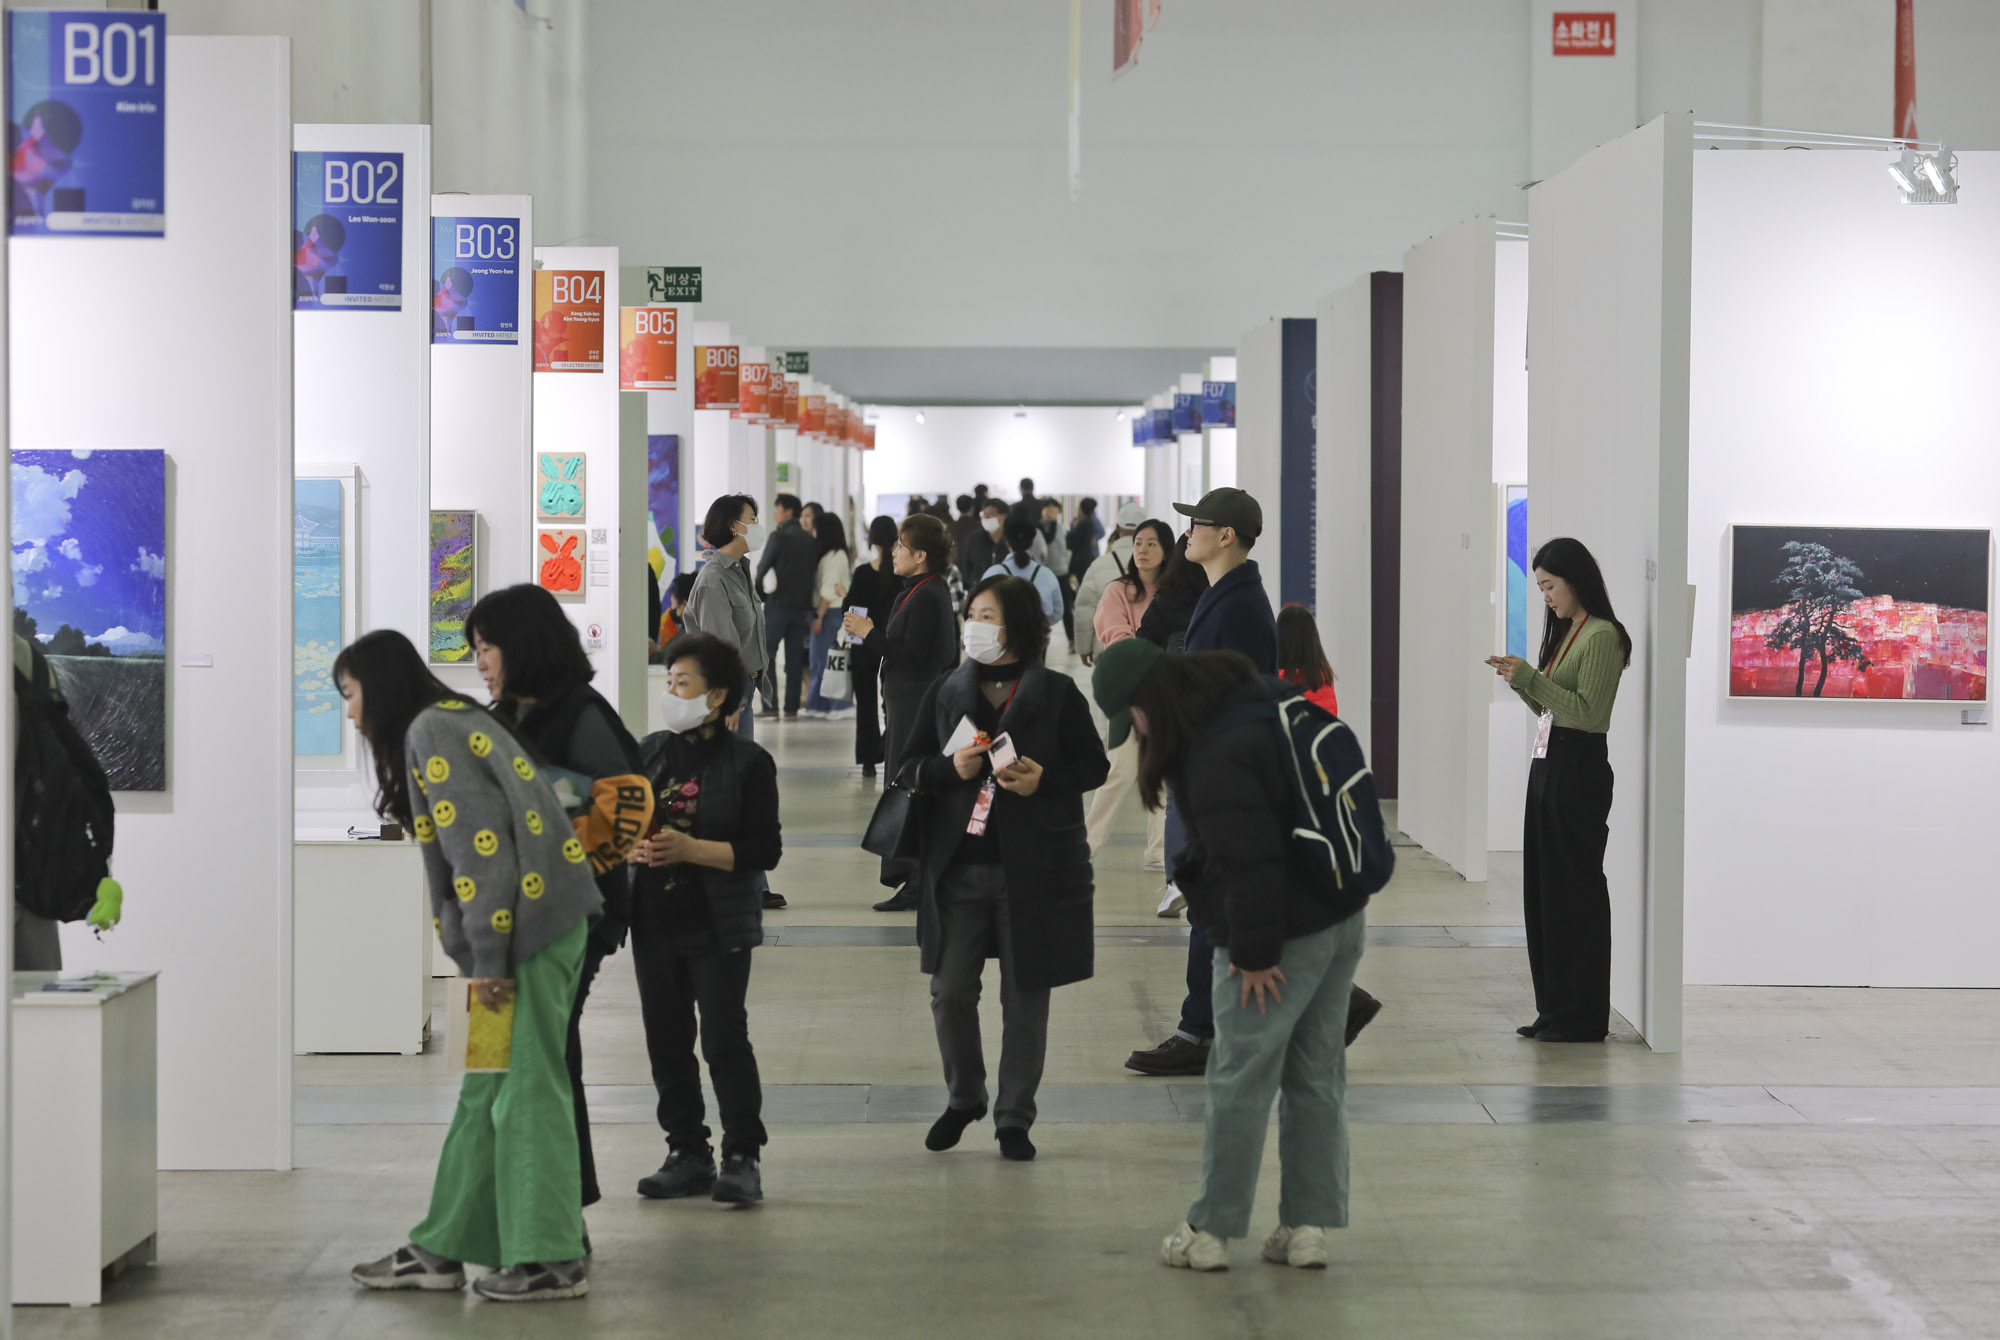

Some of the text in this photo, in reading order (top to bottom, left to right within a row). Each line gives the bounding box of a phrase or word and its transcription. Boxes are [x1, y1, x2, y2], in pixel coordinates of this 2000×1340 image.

[64, 22, 155, 86] B01
[325, 160, 398, 204] B02
[456, 223, 515, 260] B03
[471, 267, 488, 275] Jeong
[665, 273, 701, 286] 비상구
[553, 275, 602, 304] B04
[667, 286, 697, 296] EXIT
[635, 310, 675, 335] B05
[706, 348, 738, 368] B06
[741, 365, 769, 382] B07
[1203, 383, 1226, 398] F07
